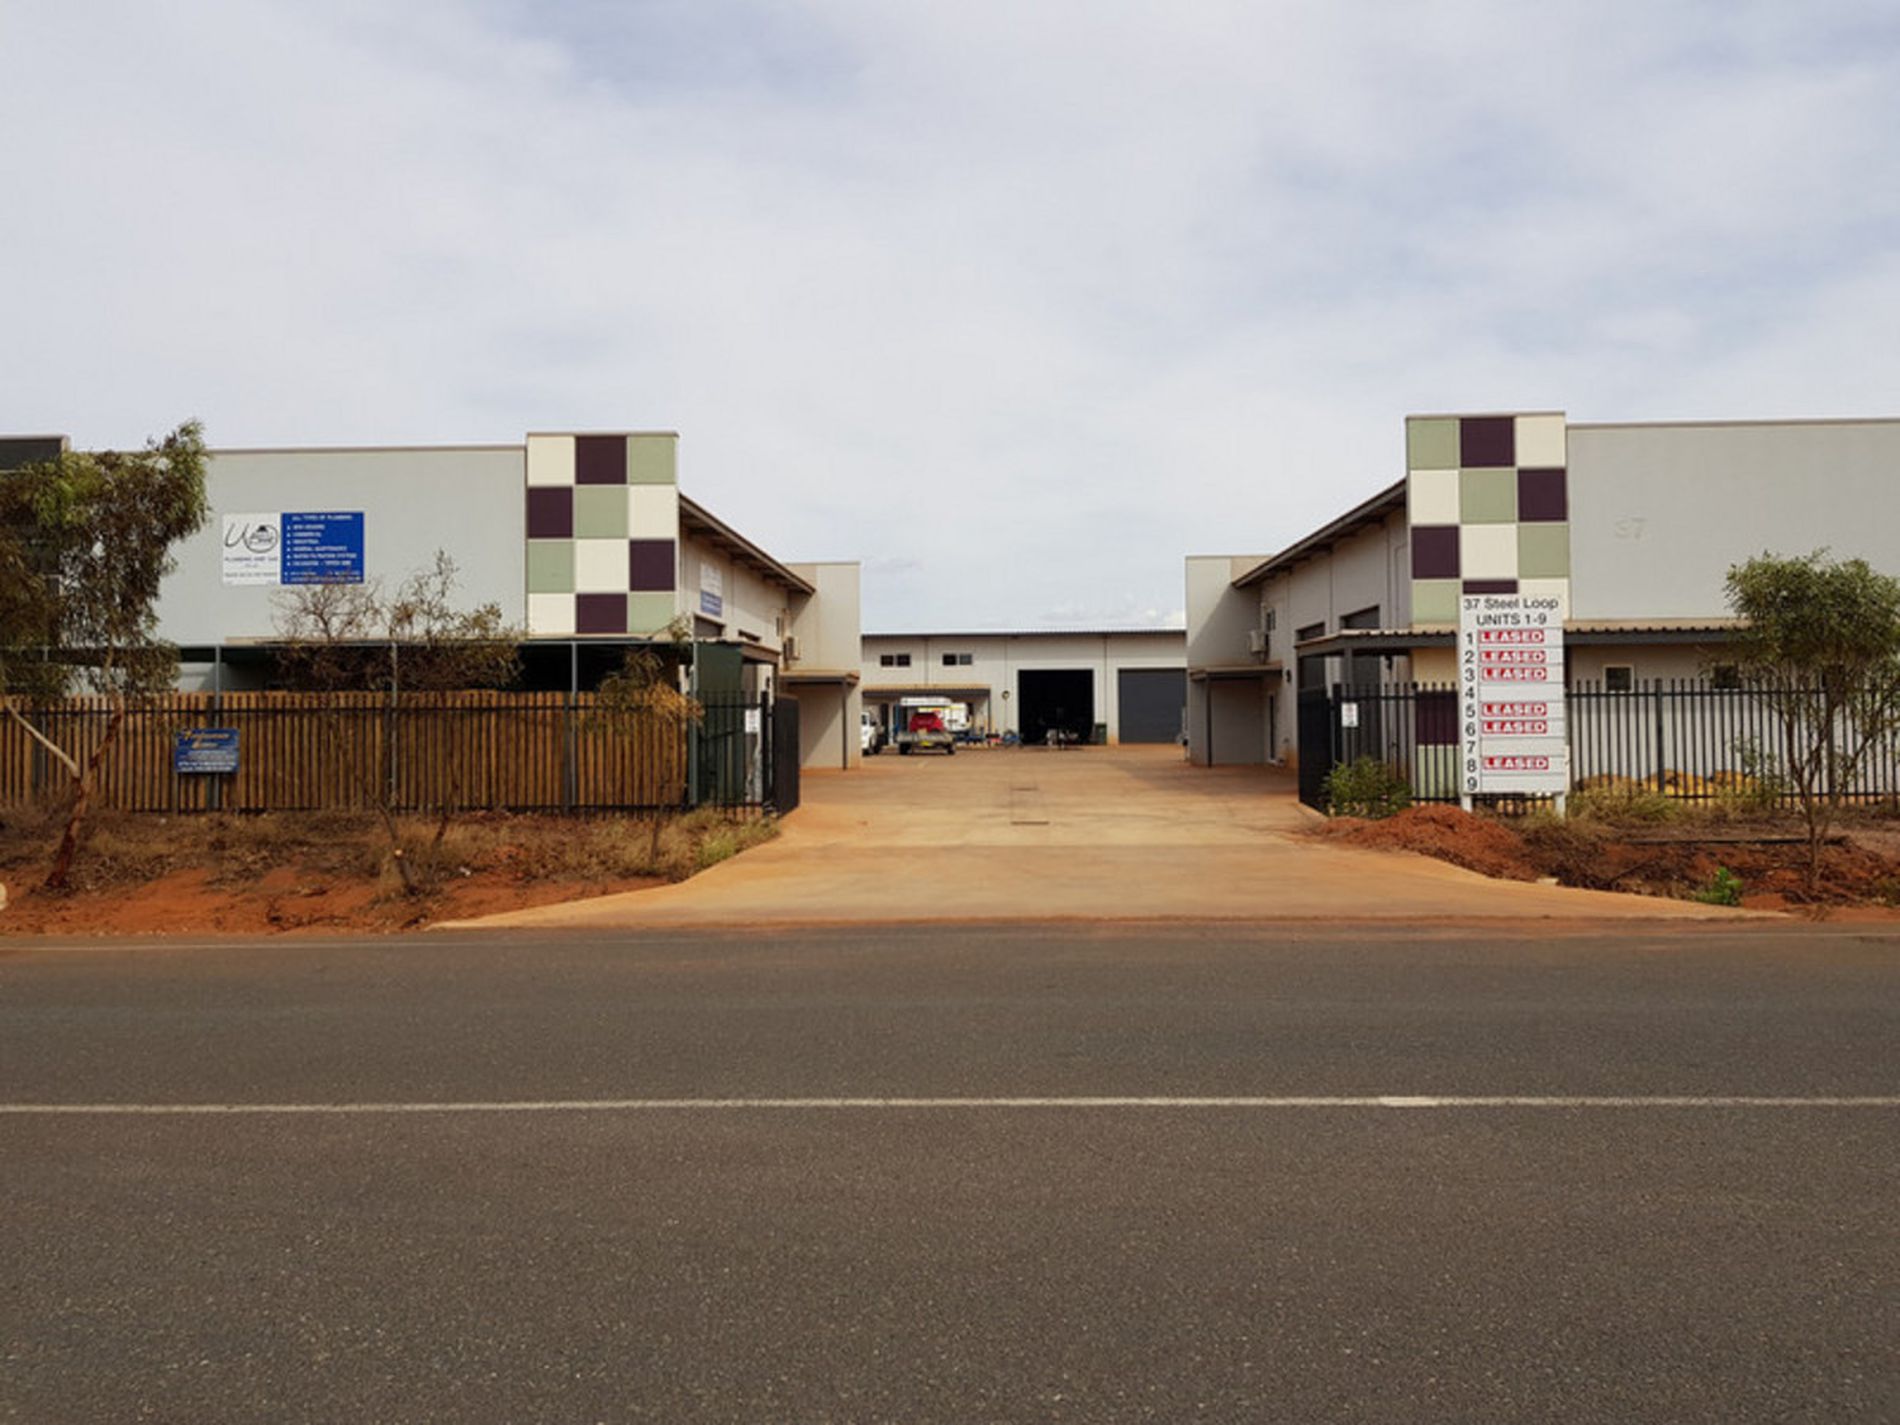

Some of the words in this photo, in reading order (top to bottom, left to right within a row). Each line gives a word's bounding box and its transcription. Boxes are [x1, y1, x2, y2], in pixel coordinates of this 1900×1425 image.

[1464, 598, 1480, 610] 37
[1484, 597, 1520, 609] Steel
[1523, 598, 1559, 610] Loop
[1476, 613, 1521, 626] UNITS
[1525, 612, 1547, 625] 1-9
[1466, 632, 1474, 645] 1
[1481, 630, 1543, 642] LEASED
[1465, 650, 1475, 664] 2
[1482, 651, 1545, 663] LEASED
[1465, 667, 1475, 682] 3
[1483, 668, 1546, 680] LEASED
[1465, 686, 1475, 699] 4
[1465, 703, 1475, 718] 5
[1483, 704, 1546, 716] LEASED
[1465, 722, 1476, 737] 6
[1483, 721, 1546, 733] LEASED
[1466, 740, 1476, 753] 7
[1467, 758, 1477, 773] 8
[1484, 757, 1547, 769] LEASED
[1467, 776, 1477, 791] 9
